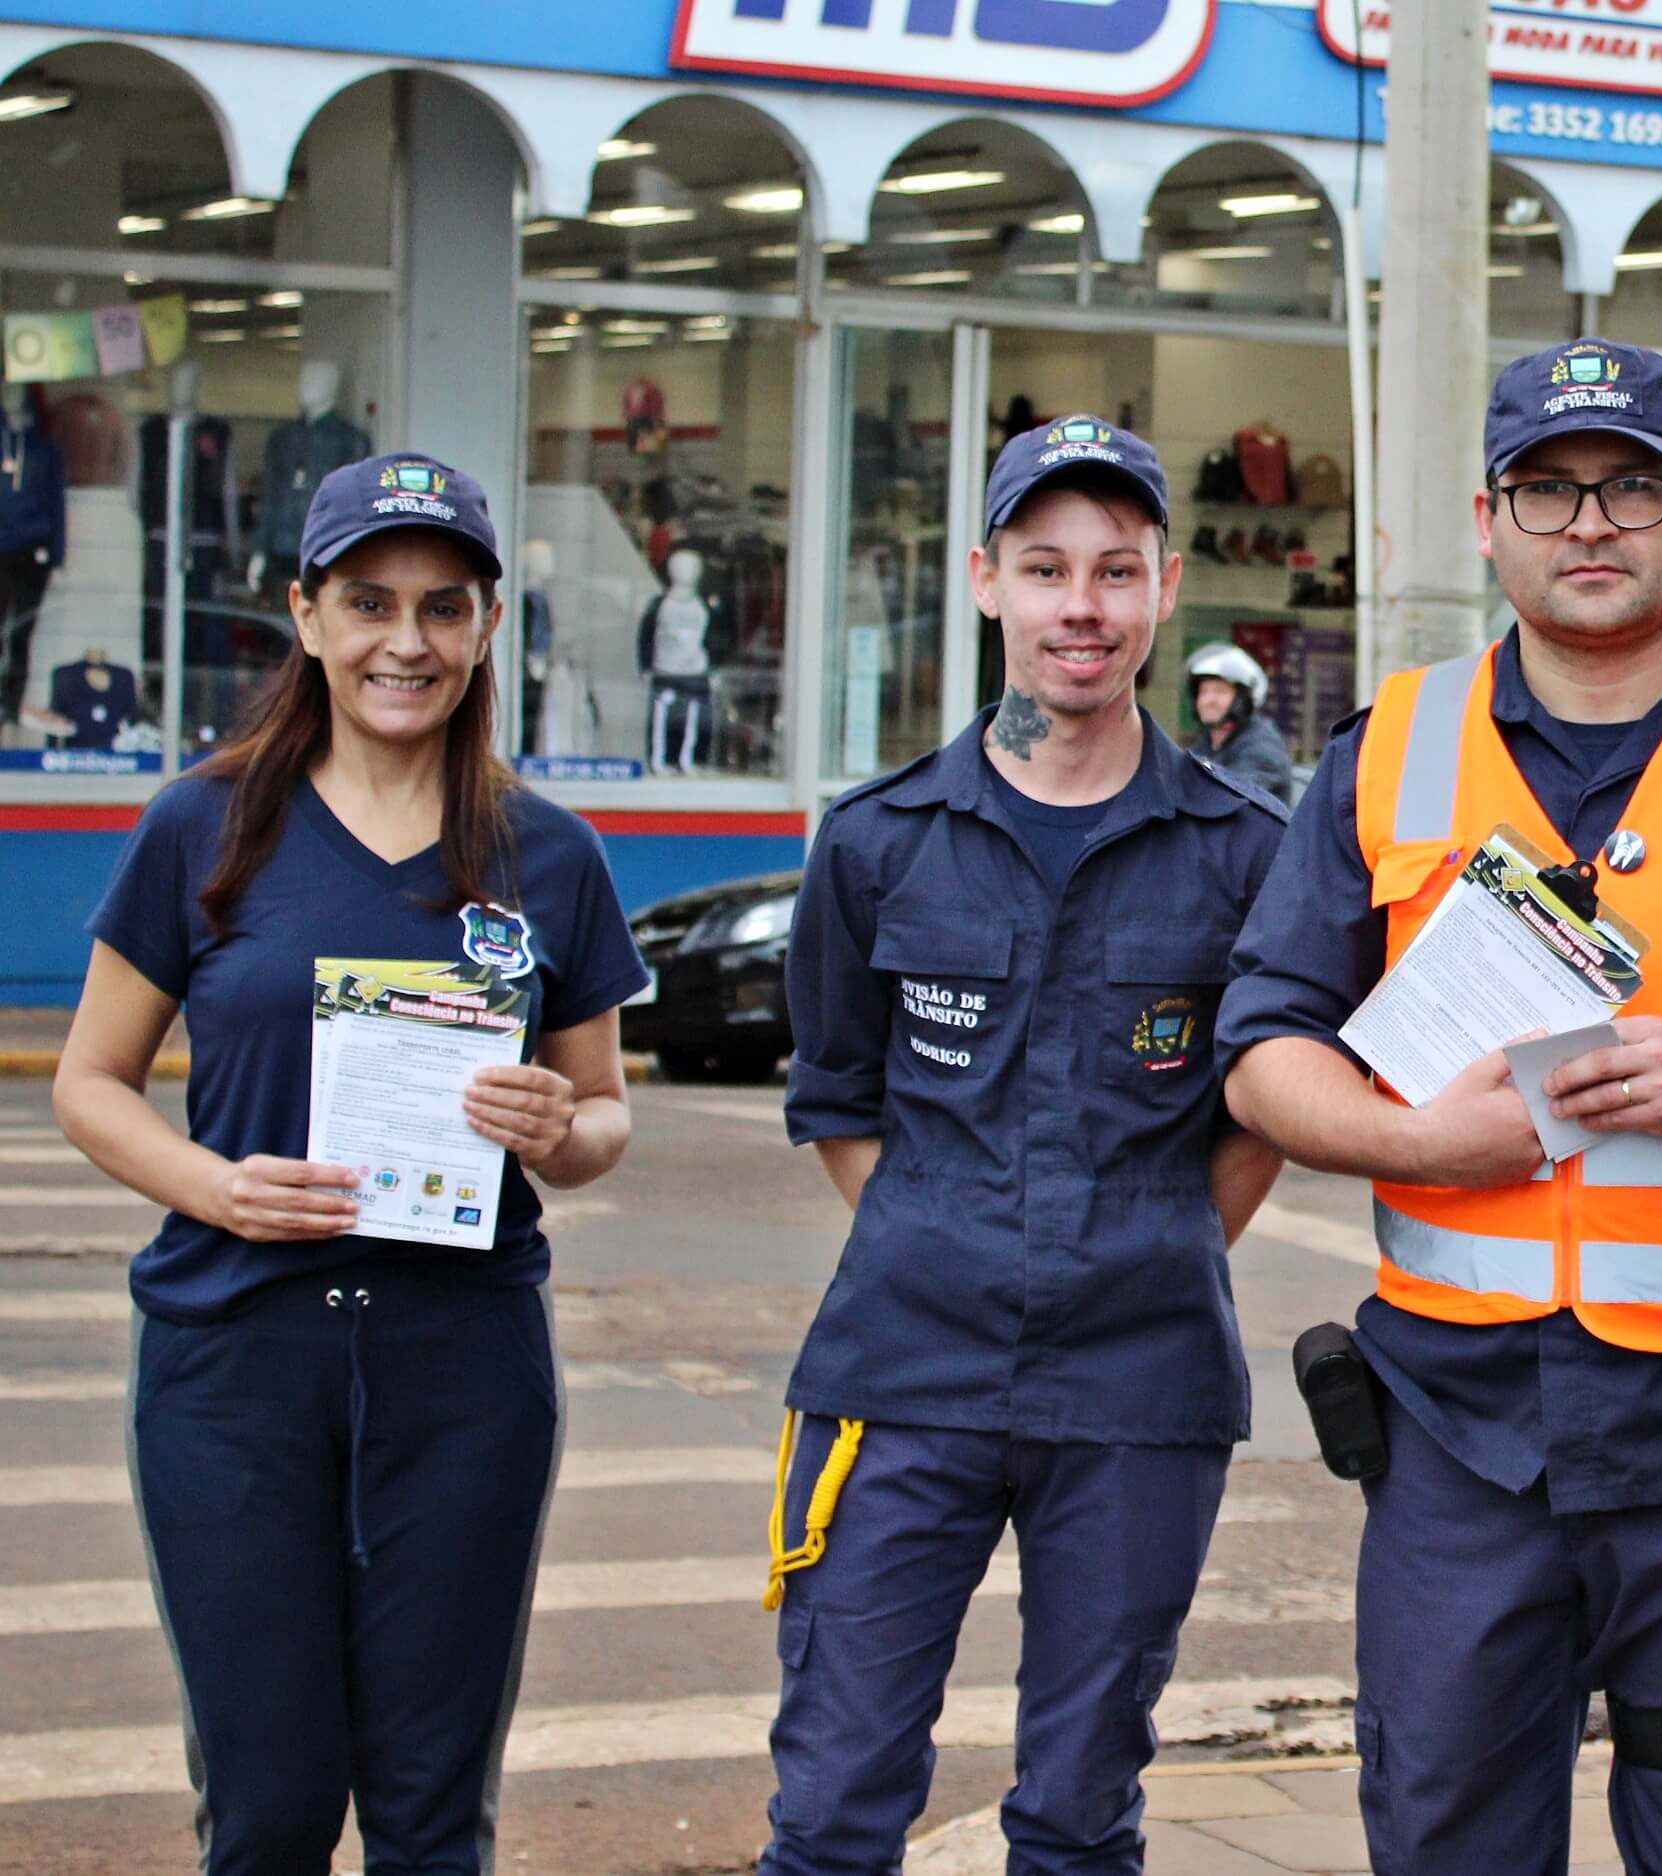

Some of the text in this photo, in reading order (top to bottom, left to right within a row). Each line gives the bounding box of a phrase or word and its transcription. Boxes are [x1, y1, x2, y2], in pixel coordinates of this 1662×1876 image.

[1505, 26, 1569, 51] MODA
[1580, 33, 1637, 59] PARA
[1527, 101, 1602, 141] 3352
[1519, 901, 1574, 957] Consciência
[1571, 951, 1587, 969] no
[1584, 961, 1622, 1002] Trânsito
[1556, 919, 1605, 967] Campanha
[902, 993, 978, 1029] TRÂNSITO
[960, 992, 986, 1011] DE
[910, 1035, 971, 1067] ODRIGO
